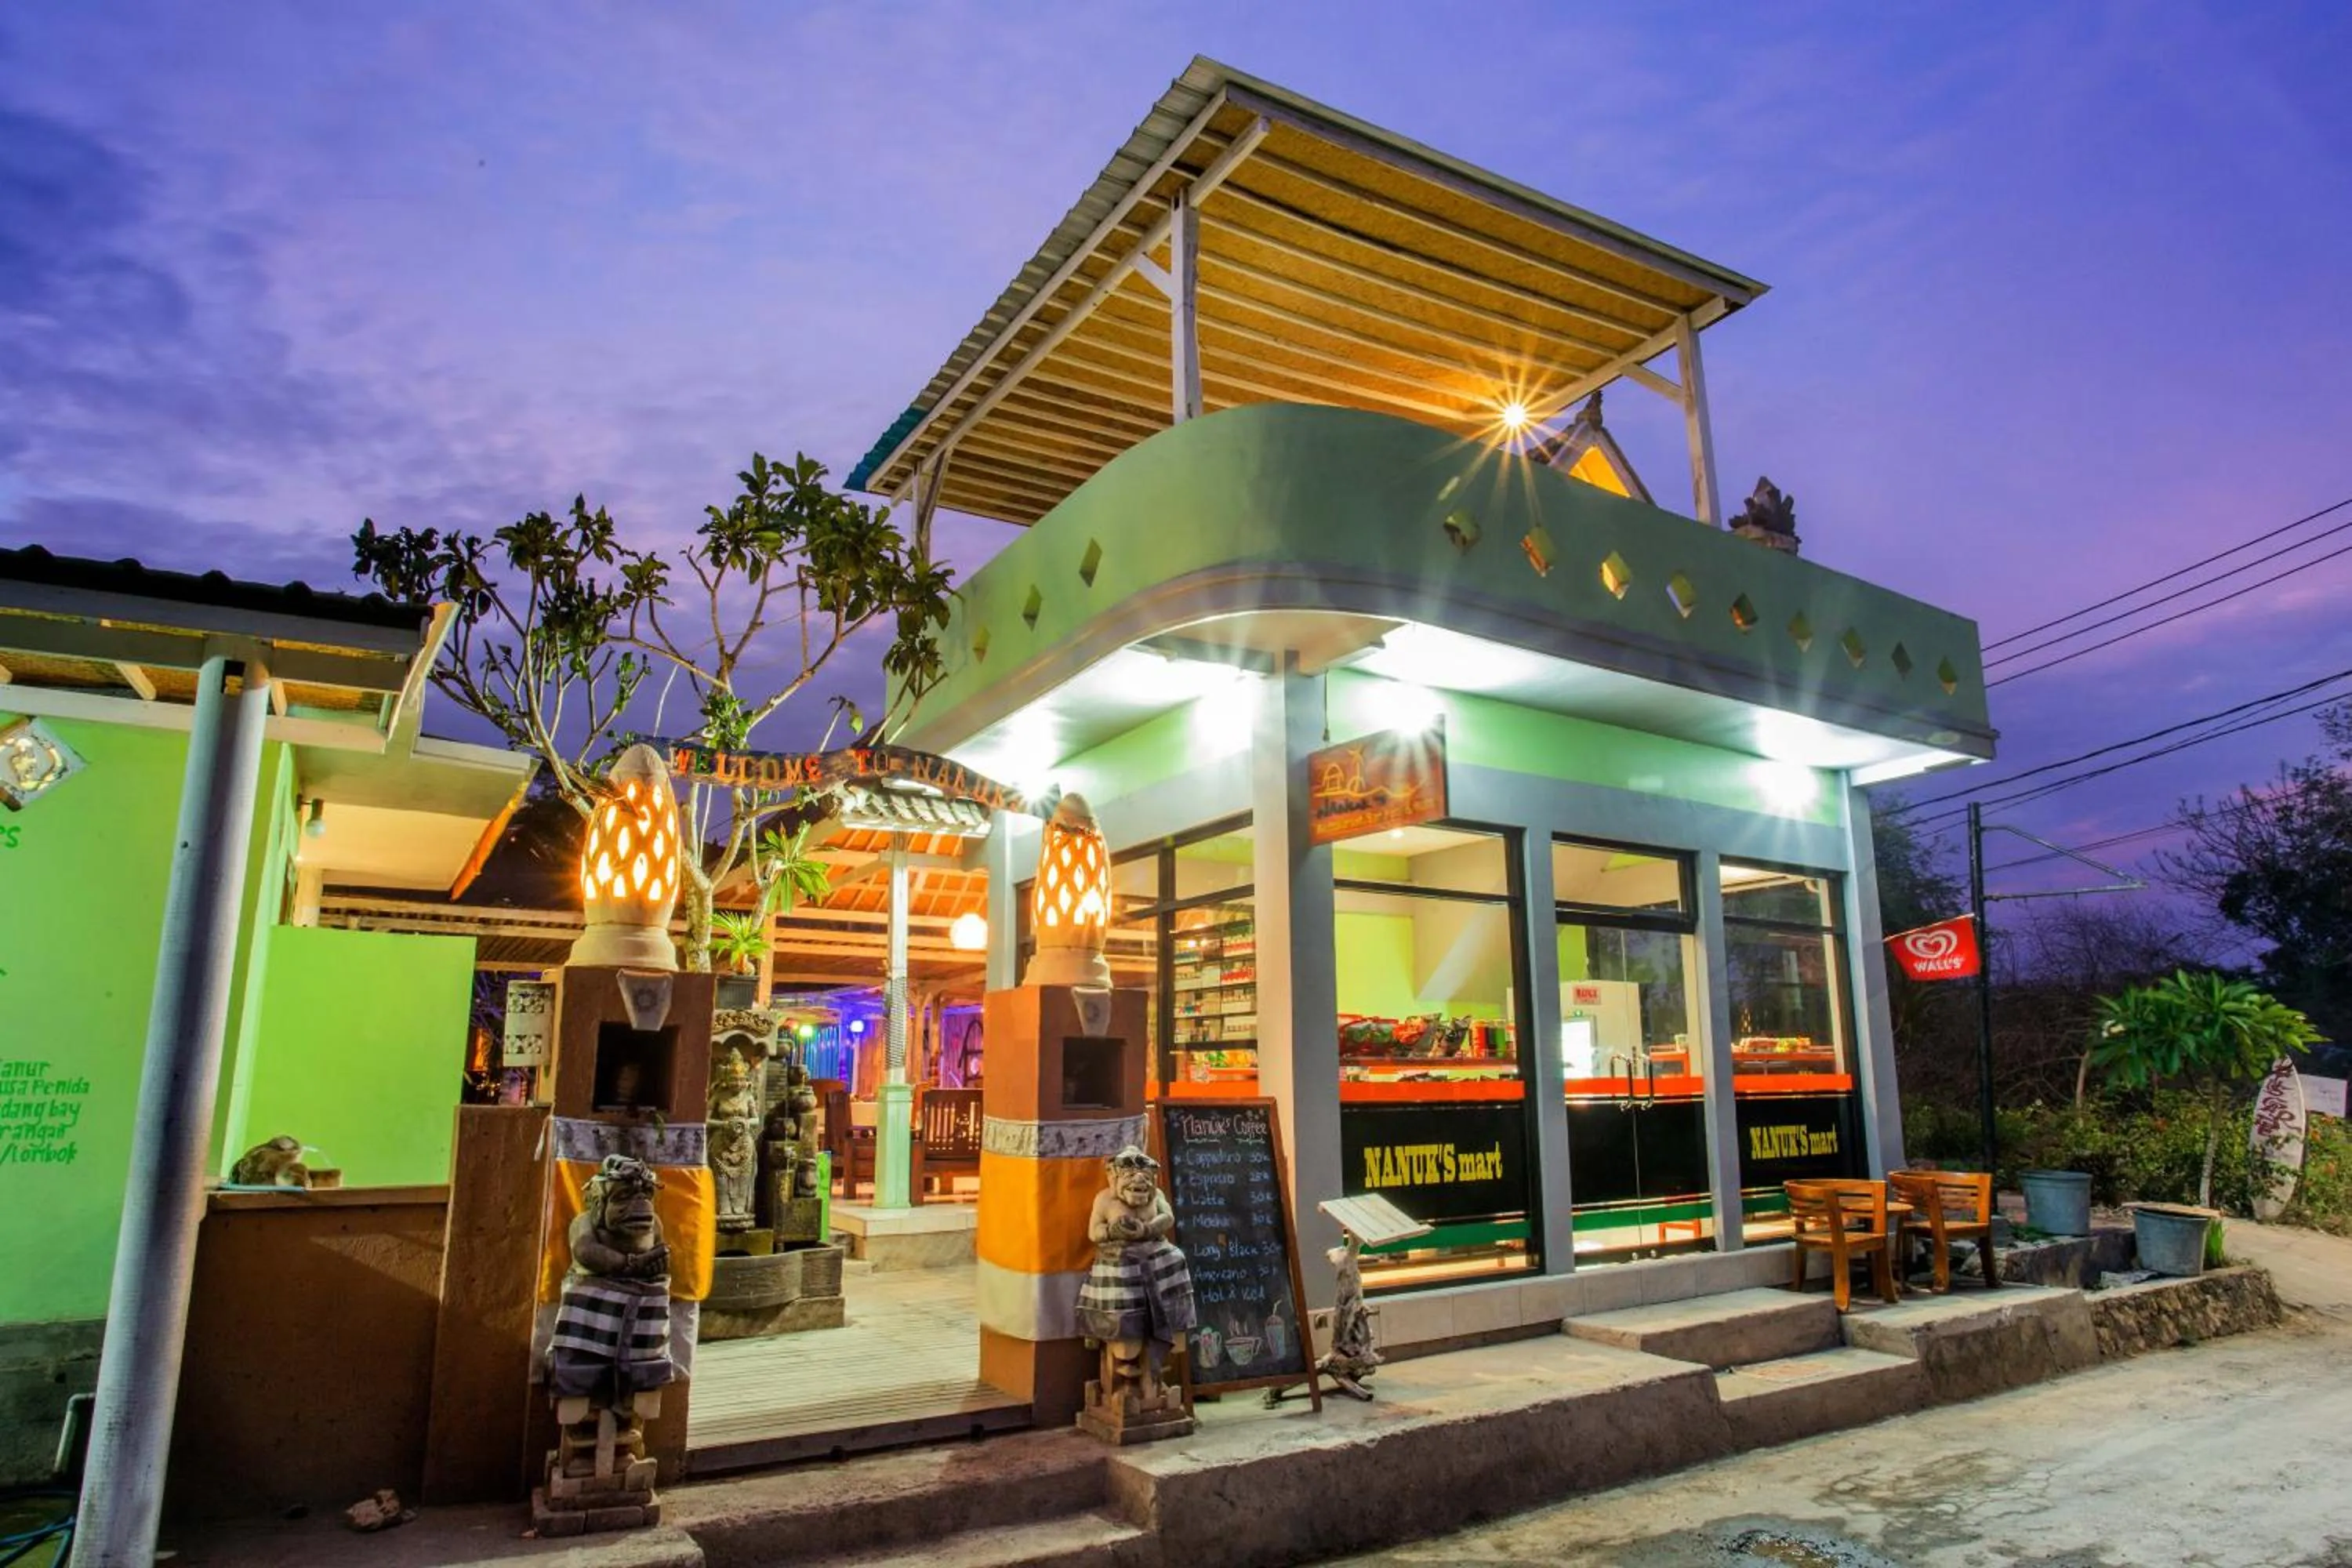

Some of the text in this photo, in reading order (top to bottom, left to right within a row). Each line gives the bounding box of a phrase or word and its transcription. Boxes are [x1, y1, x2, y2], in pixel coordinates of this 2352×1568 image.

[670, 746, 822, 784] WELCOME
[853, 749, 889, 776] TO
[0, 1061, 50, 1077] anur
[1750, 1123, 1838, 1160] NANUK'S mart
[1364, 1141, 1503, 1189] NANUK'S mart
